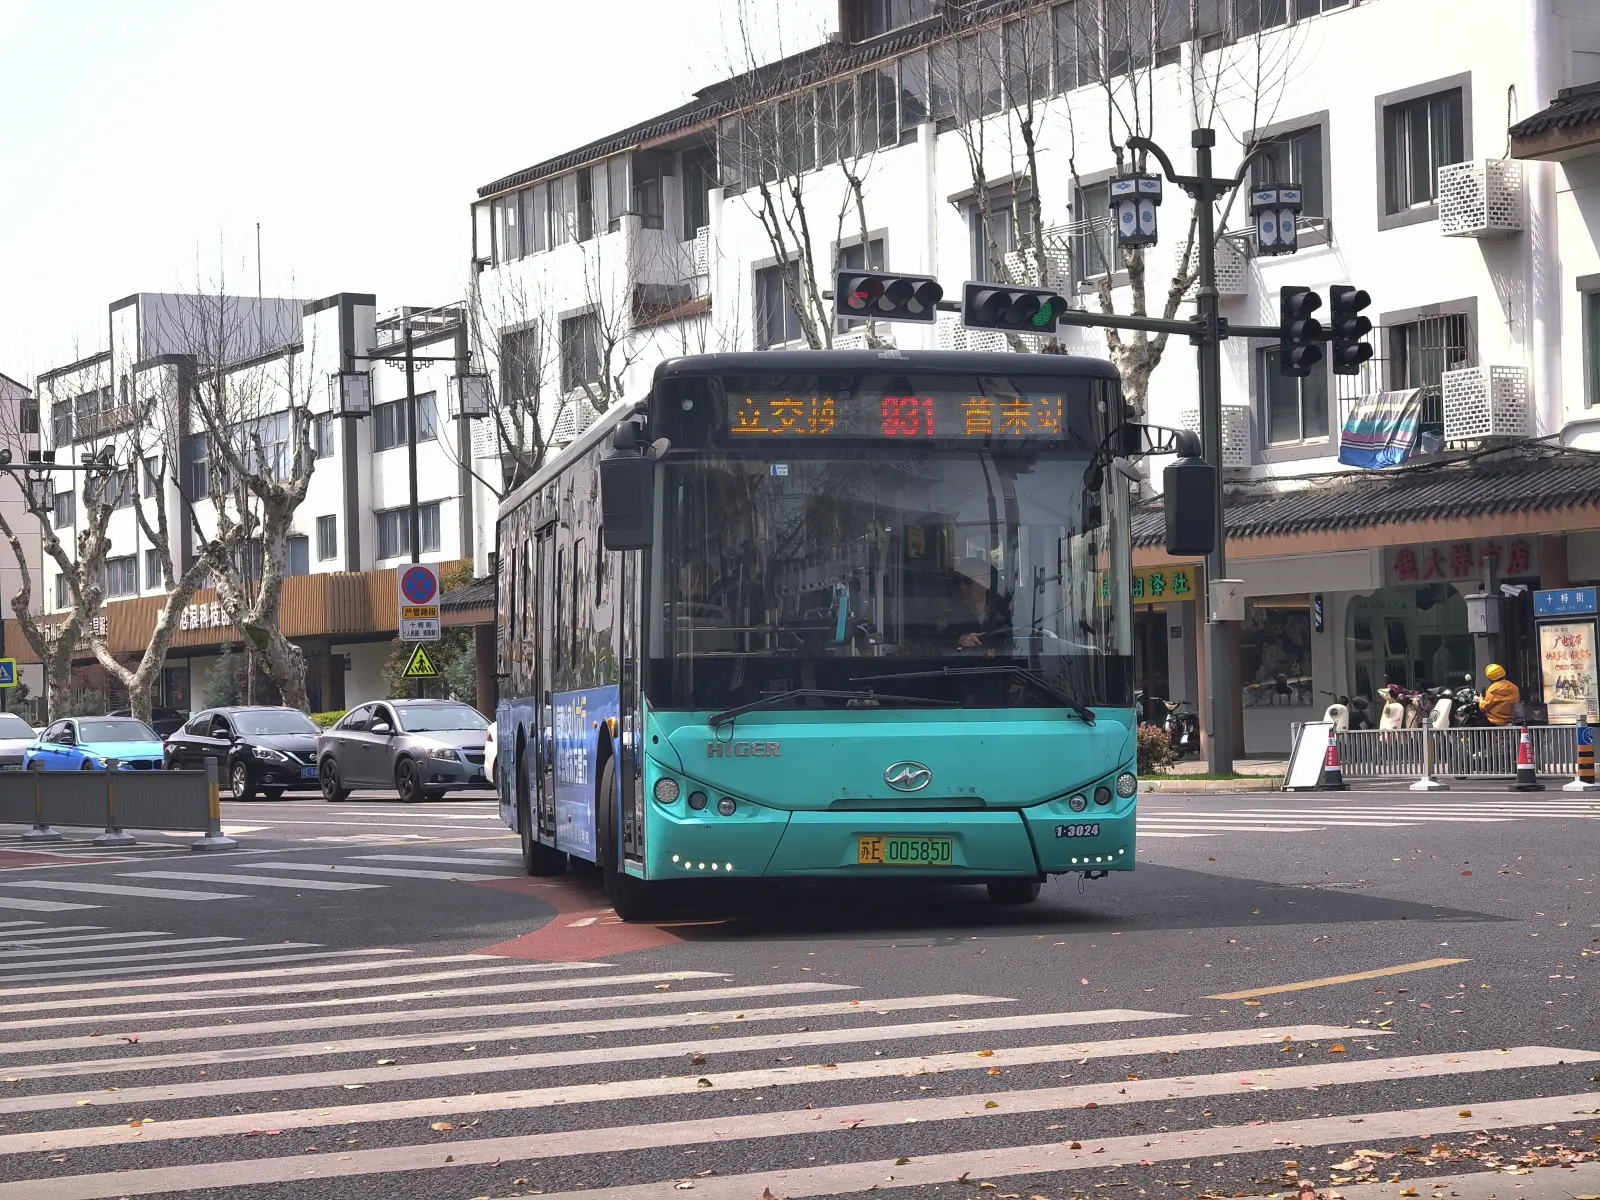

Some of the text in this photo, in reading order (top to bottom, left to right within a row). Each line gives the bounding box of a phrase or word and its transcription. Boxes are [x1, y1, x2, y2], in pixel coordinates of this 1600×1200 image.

[961, 396, 1063, 435] 首末站
[404, 607, 436, 617] 严管路段
[1553, 634, 1582, 649] 广电宽带
[707, 741, 781, 758] HIGER
